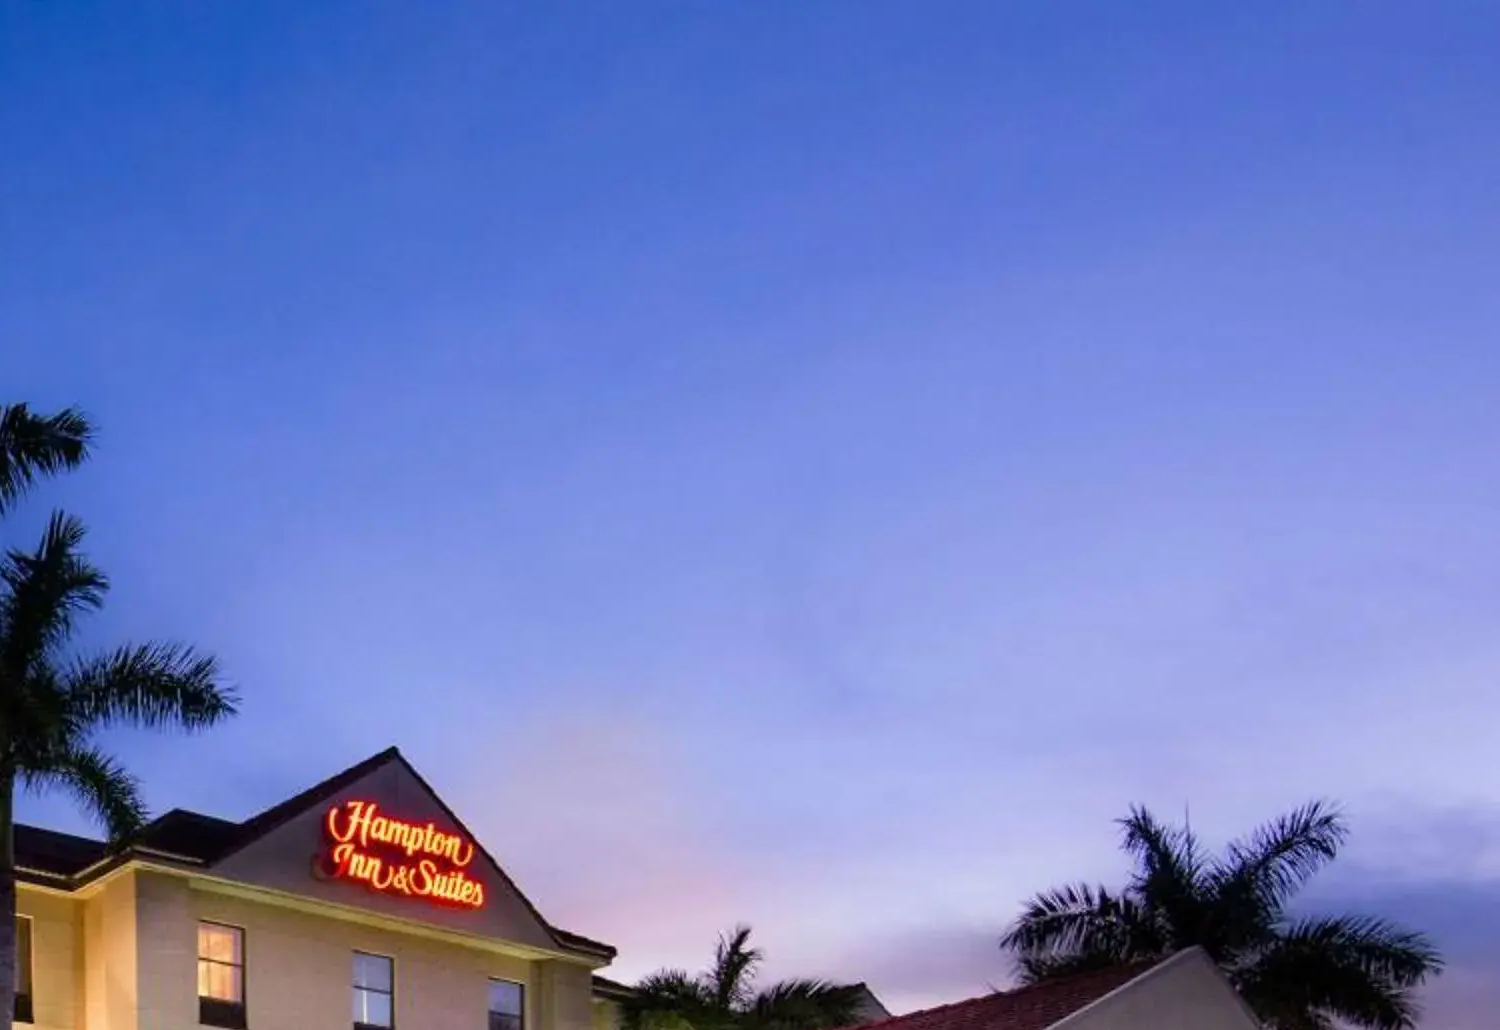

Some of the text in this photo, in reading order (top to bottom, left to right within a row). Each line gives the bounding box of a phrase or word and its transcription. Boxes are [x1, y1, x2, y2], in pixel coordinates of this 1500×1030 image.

[329, 801, 473, 867] Hampton
[330, 844, 394, 889] Inn
[409, 859, 484, 907] Suites
